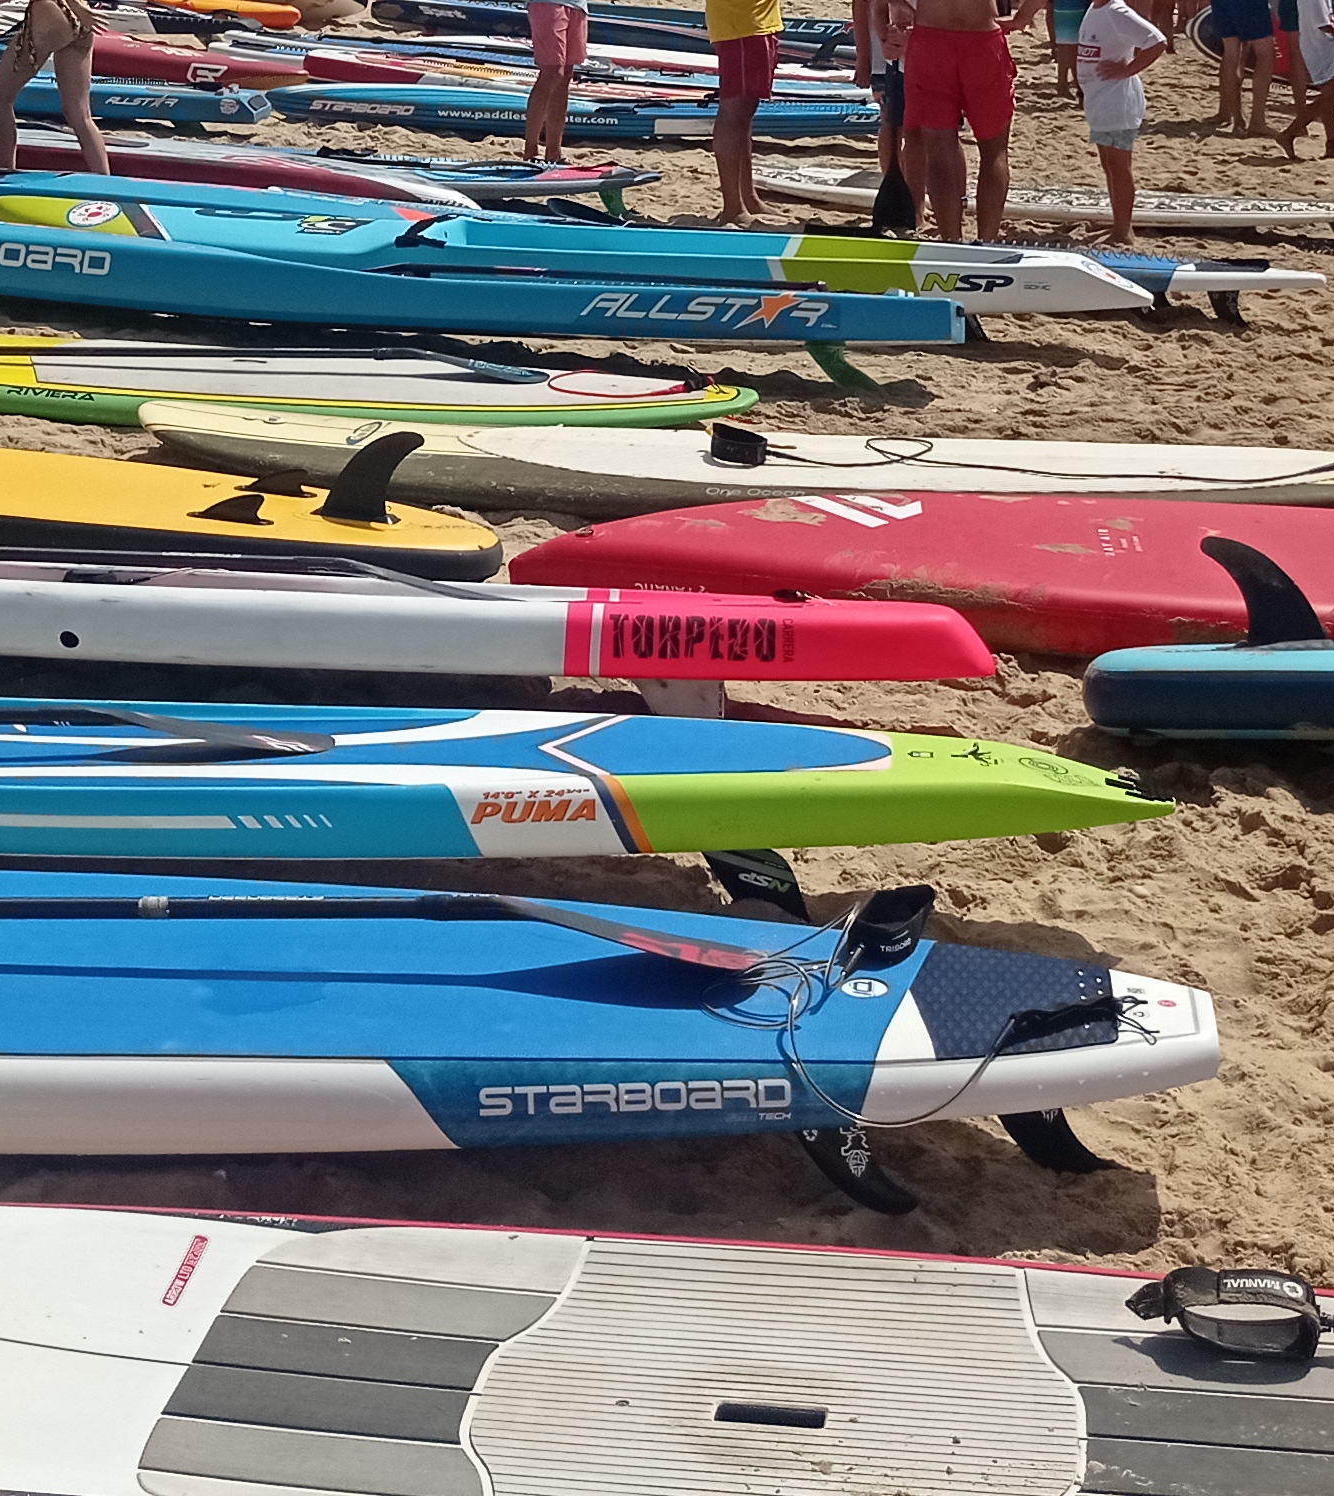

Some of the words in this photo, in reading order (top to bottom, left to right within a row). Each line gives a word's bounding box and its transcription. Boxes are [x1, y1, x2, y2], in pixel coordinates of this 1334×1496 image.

[309, 100, 416, 117] STARBOARD
[920, 271, 1015, 294] NSP
[579, 289, 830, 330] ALLSTAR
[6, 386, 96, 402] RIVIERA
[608, 612, 777, 663] TORPEDO
[783, 617, 795, 663] CARRERA
[470, 799, 597, 825] PUMA
[738, 871, 792, 893] NSP
[478, 1077, 792, 1117] STARBOARD
[758, 1112, 792, 1120] TECH
[1224, 1277, 1282, 1290] MANUAL
